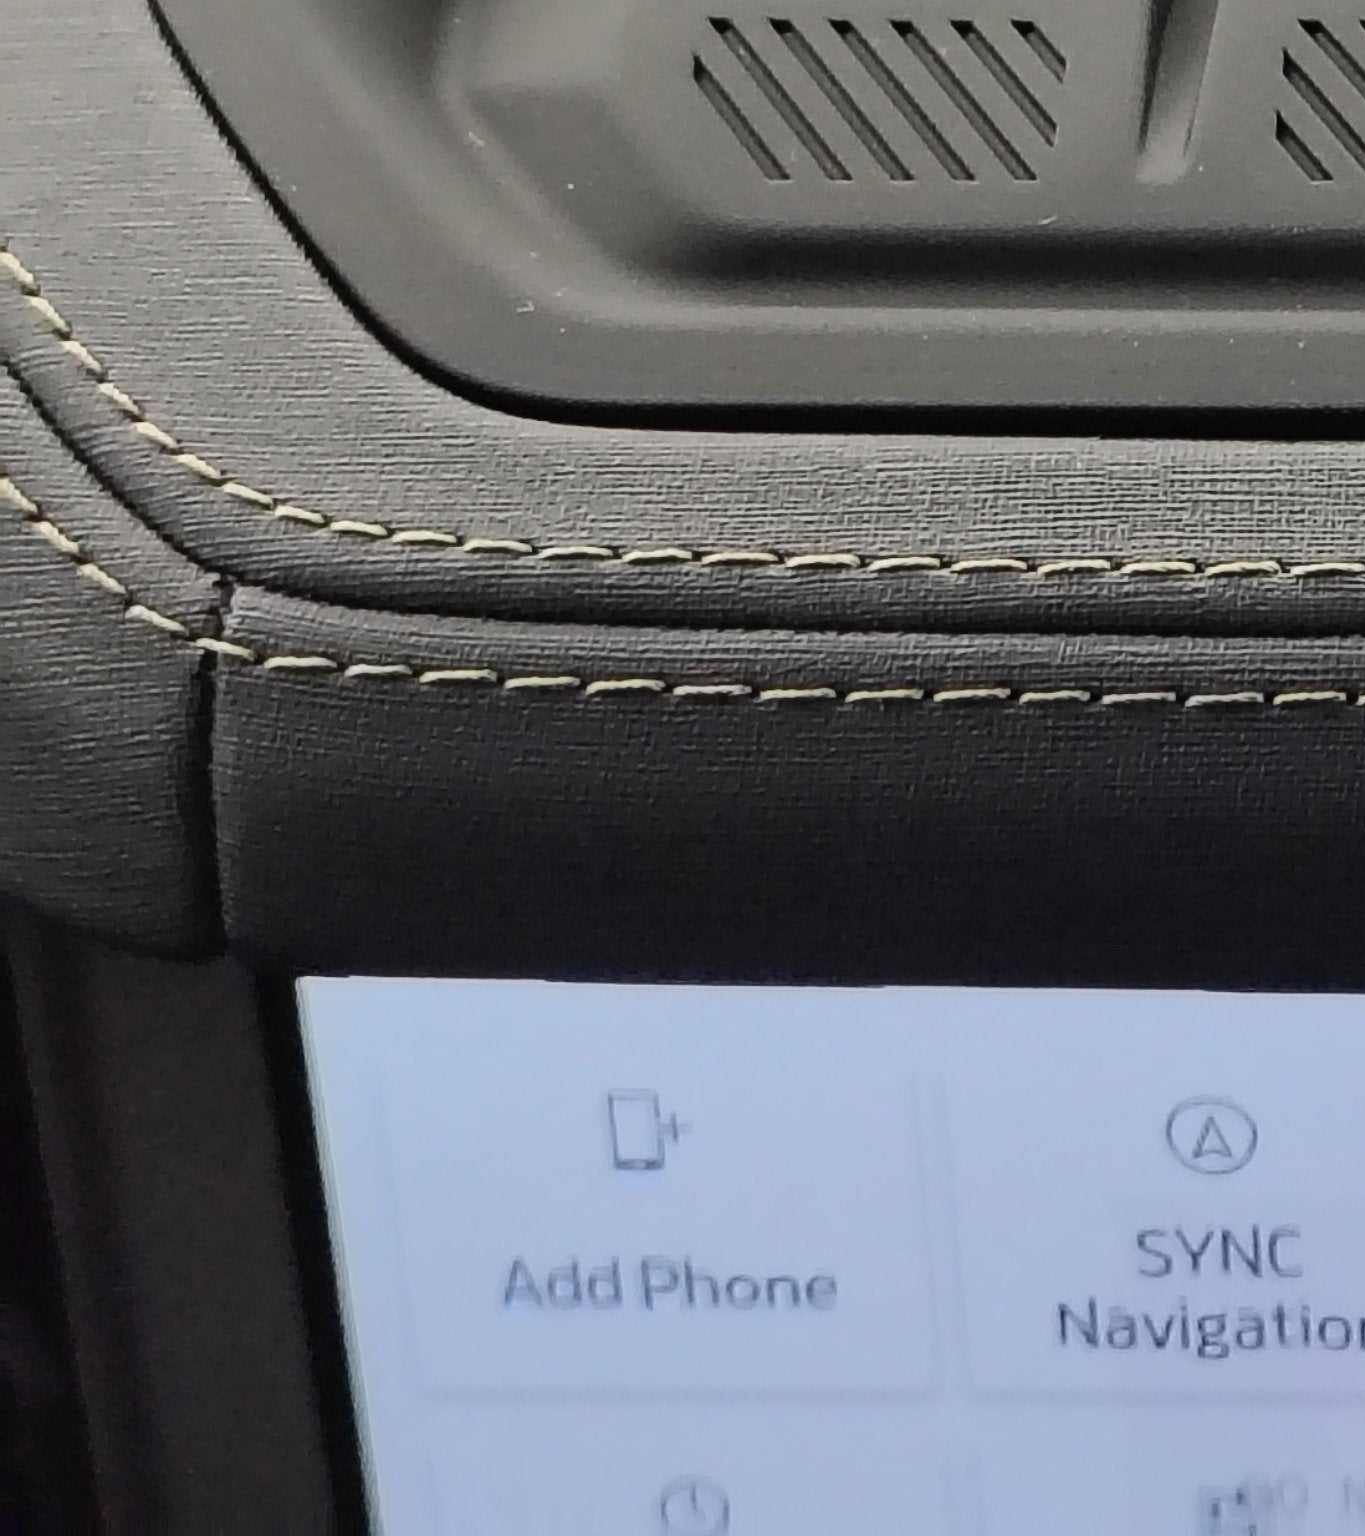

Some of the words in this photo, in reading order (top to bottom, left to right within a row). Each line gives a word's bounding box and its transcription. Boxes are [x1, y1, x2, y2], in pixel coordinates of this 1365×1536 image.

[1135, 1224, 1304, 1279] SYNC
[502, 1256, 623, 1311] Add
[641, 1254, 839, 1312] Phone
